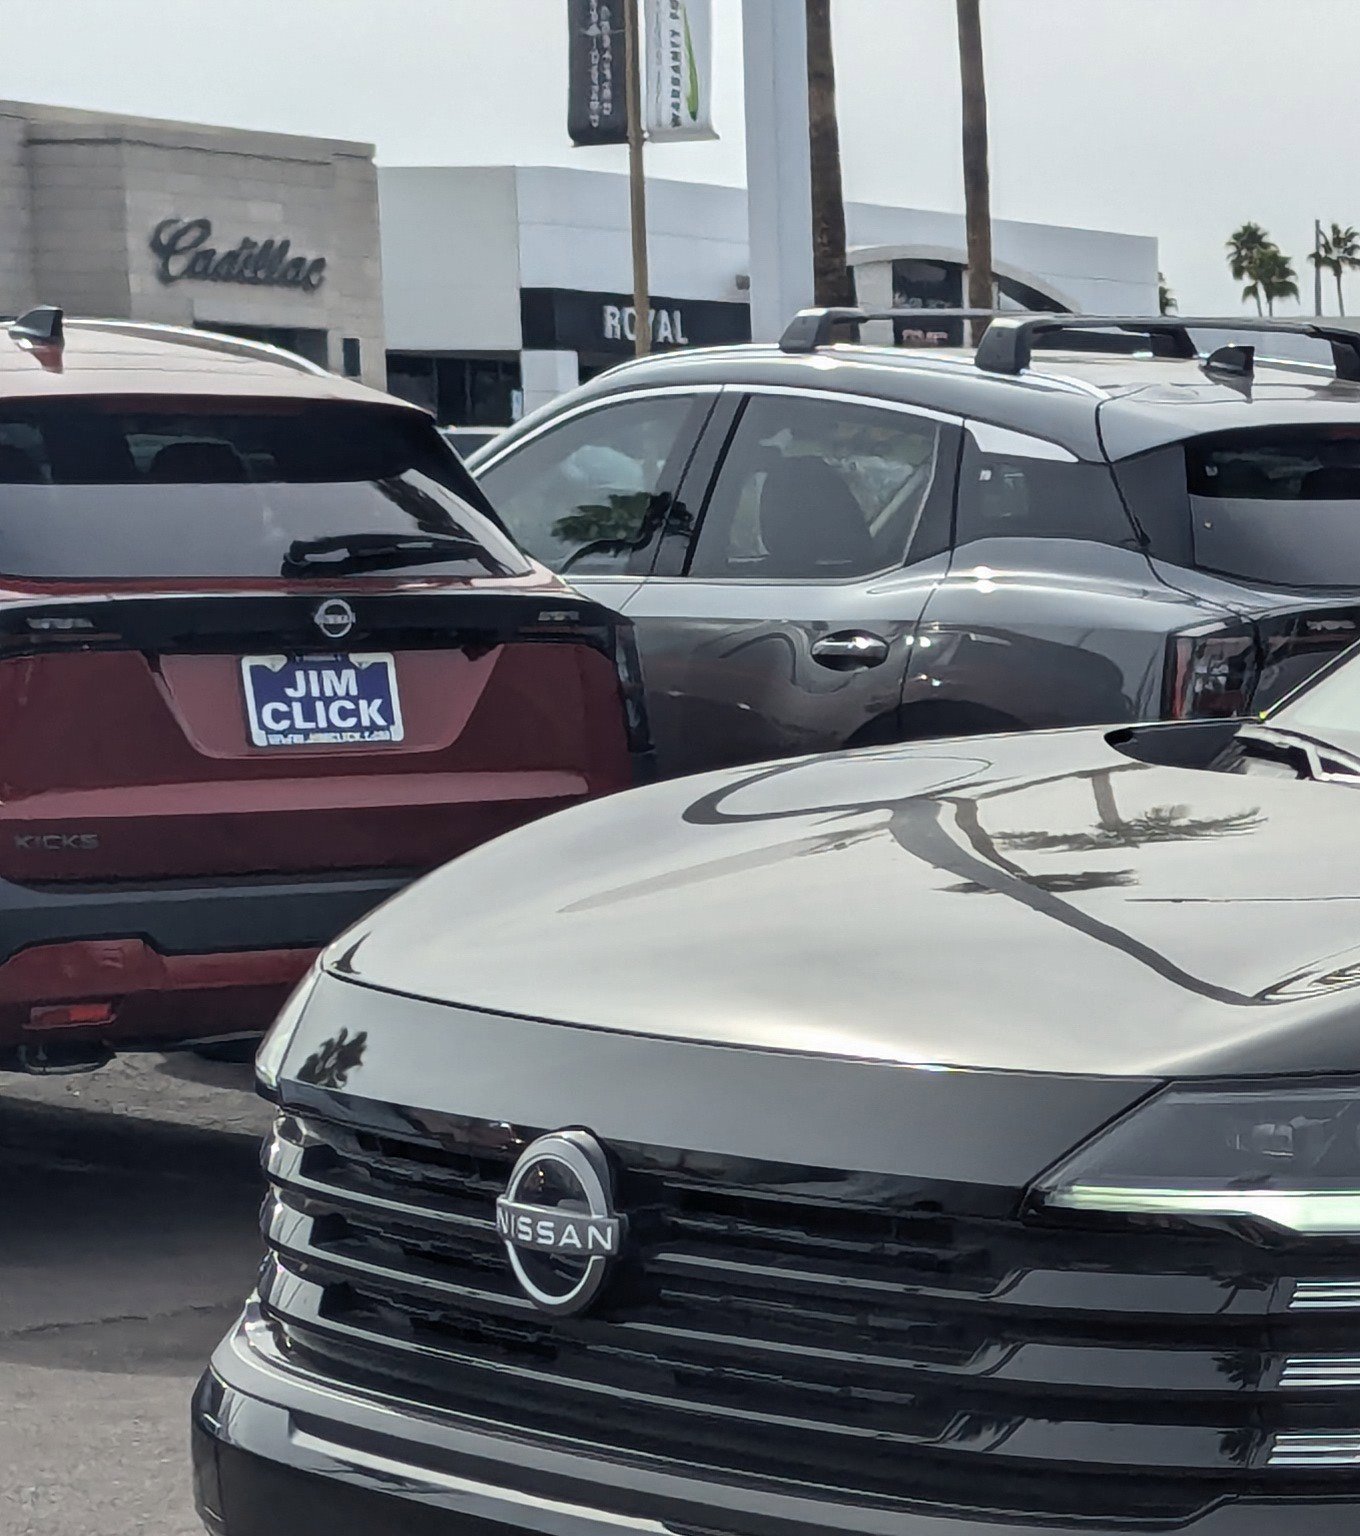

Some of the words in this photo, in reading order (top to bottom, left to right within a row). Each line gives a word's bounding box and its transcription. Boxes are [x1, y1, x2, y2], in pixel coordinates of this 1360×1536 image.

[149, 218, 327, 294] Cadillac
[284, 668, 359, 698] JIM
[261, 698, 388, 731] CLICK
[499, 1207, 613, 1251] NISSAN
